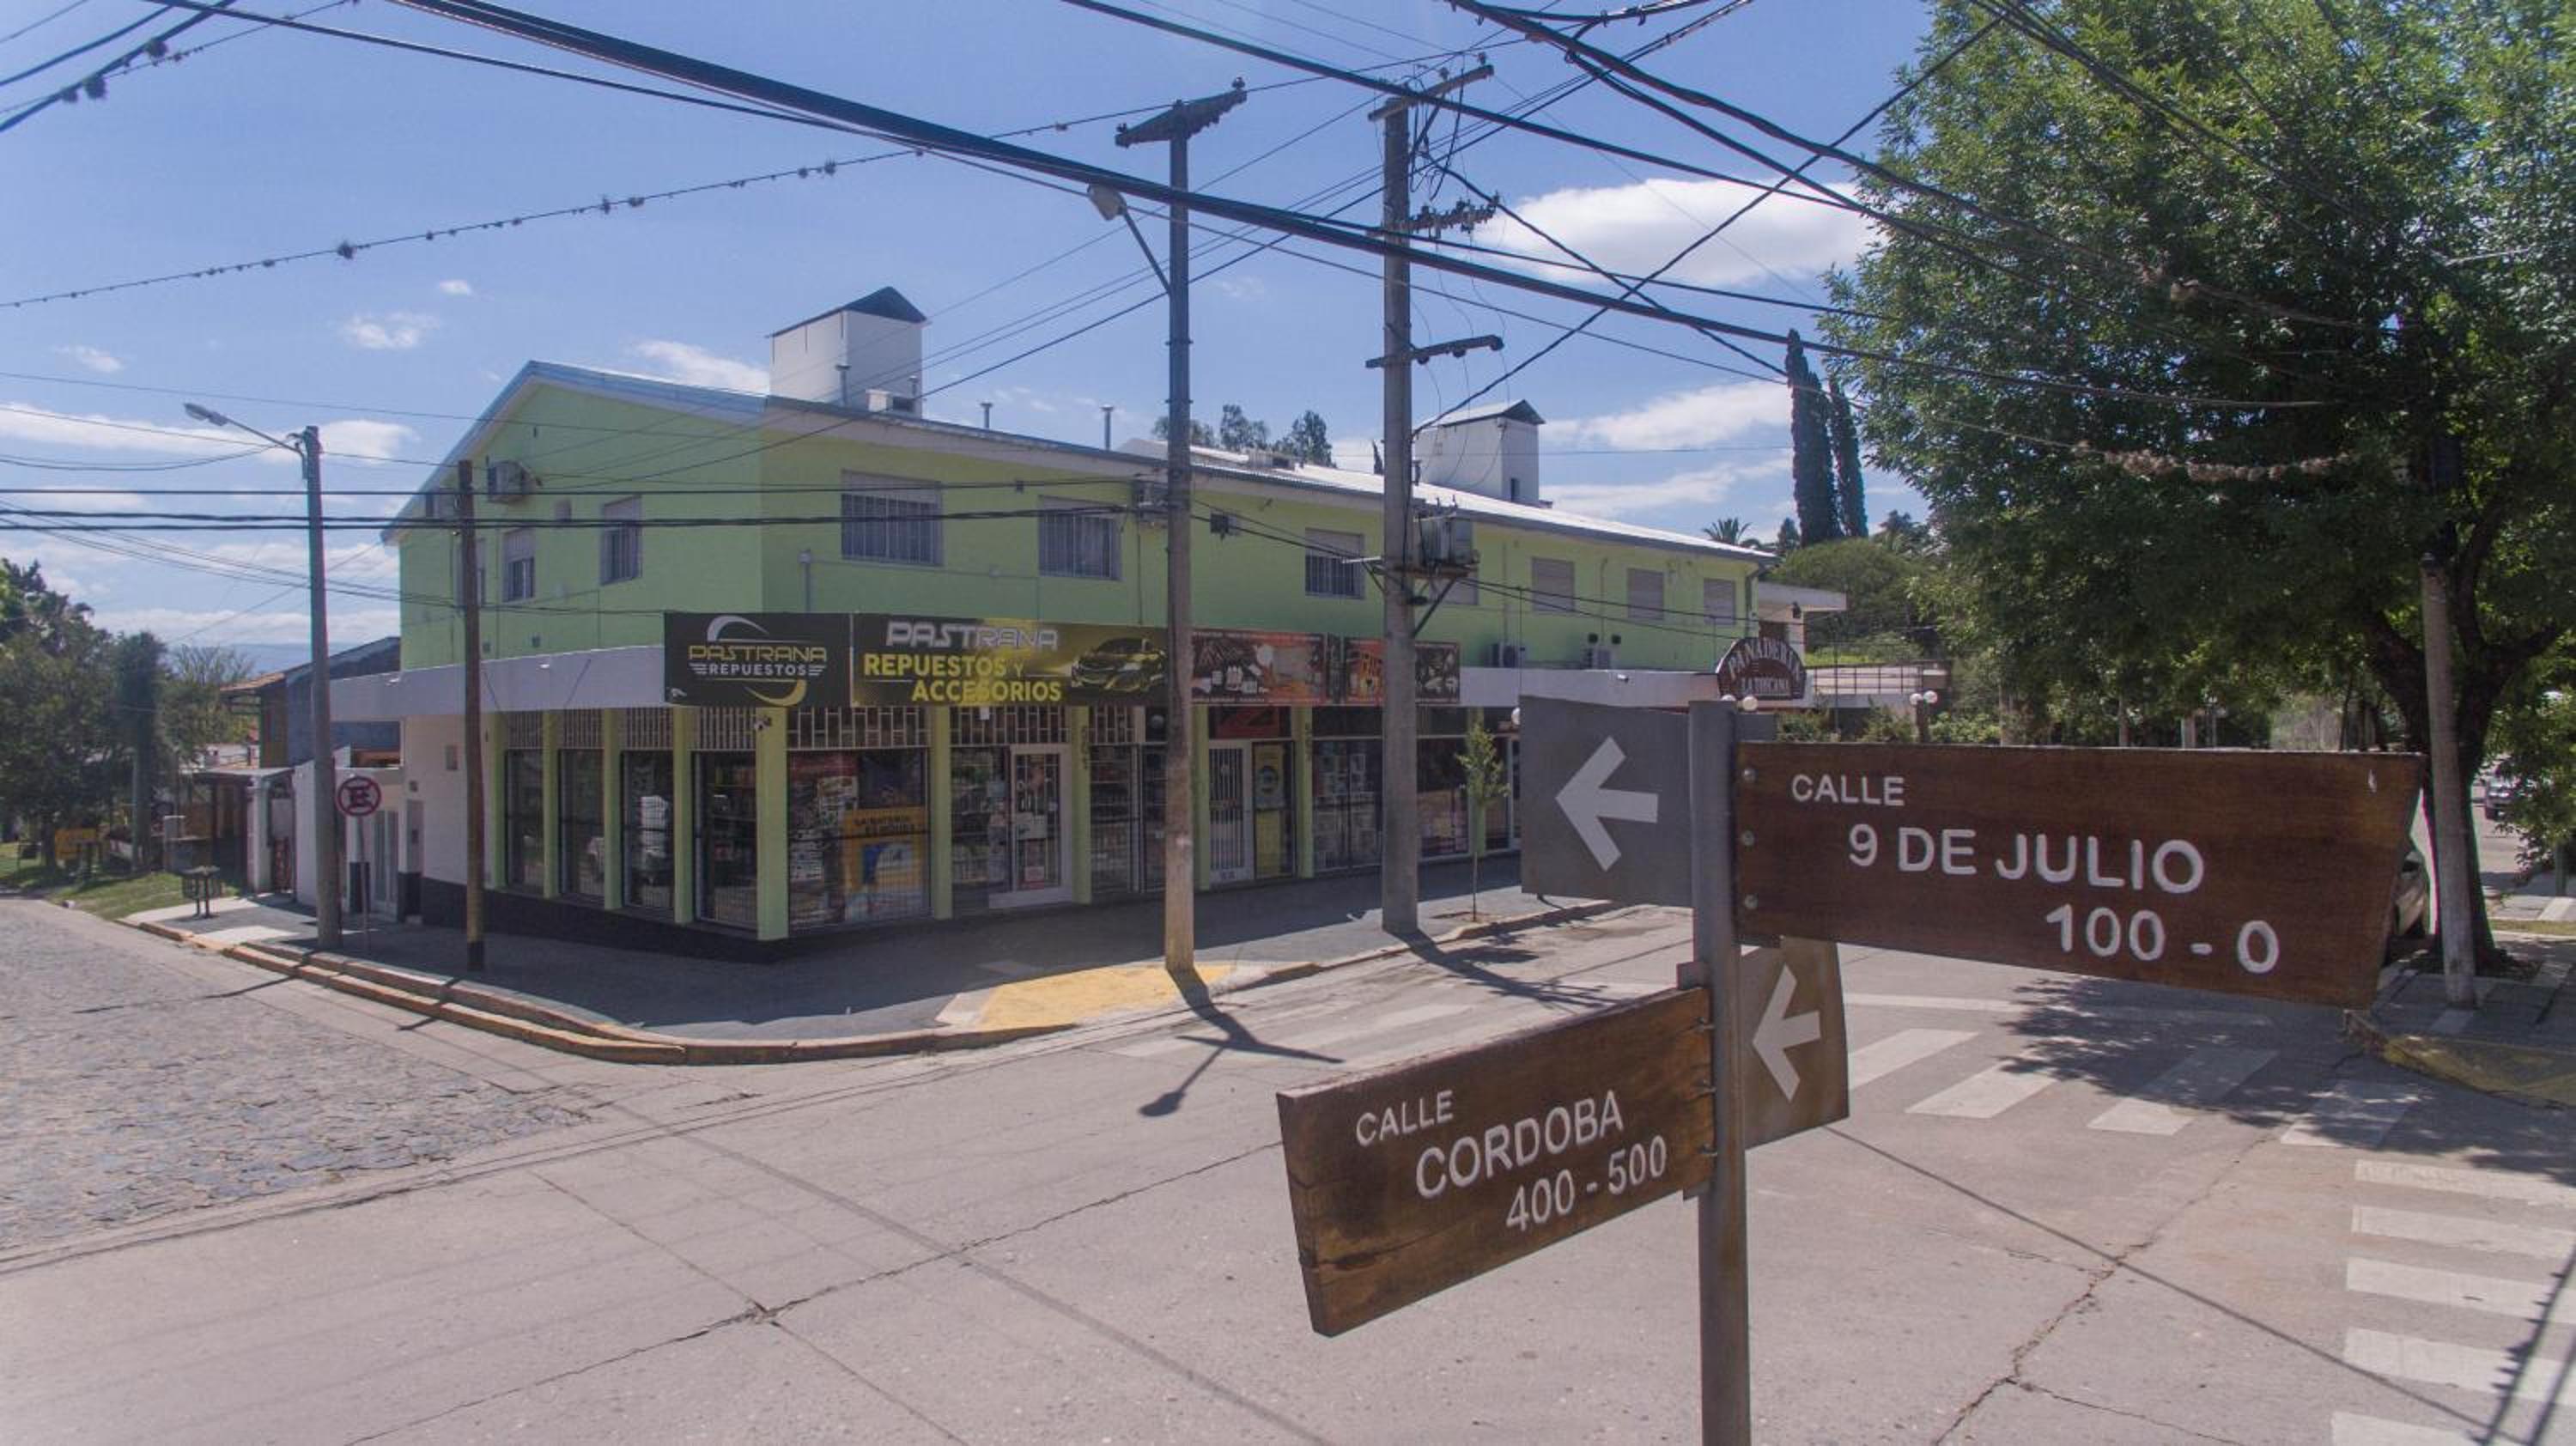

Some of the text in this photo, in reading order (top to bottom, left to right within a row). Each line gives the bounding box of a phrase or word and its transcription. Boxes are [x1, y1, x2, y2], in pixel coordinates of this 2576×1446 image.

[885, 621, 1059, 651] PASTRANA
[689, 645, 828, 662] PASTRANA
[708, 663, 806, 676] REPUESTOS
[864, 653, 1025, 677] REPUESTOS Y
[912, 679, 1062, 702] ACCESORIOS
[1791, 774, 1905, 807] CALLE
[1848, 823, 2205, 894] 9 DE JULIO
[2045, 903, 2280, 974] 100 - 0
[1355, 1089, 1454, 1147] CALLE
[1415, 1089, 1624, 1200] CORDOBA
[1504, 1134, 1668, 1232] 400 - 500
